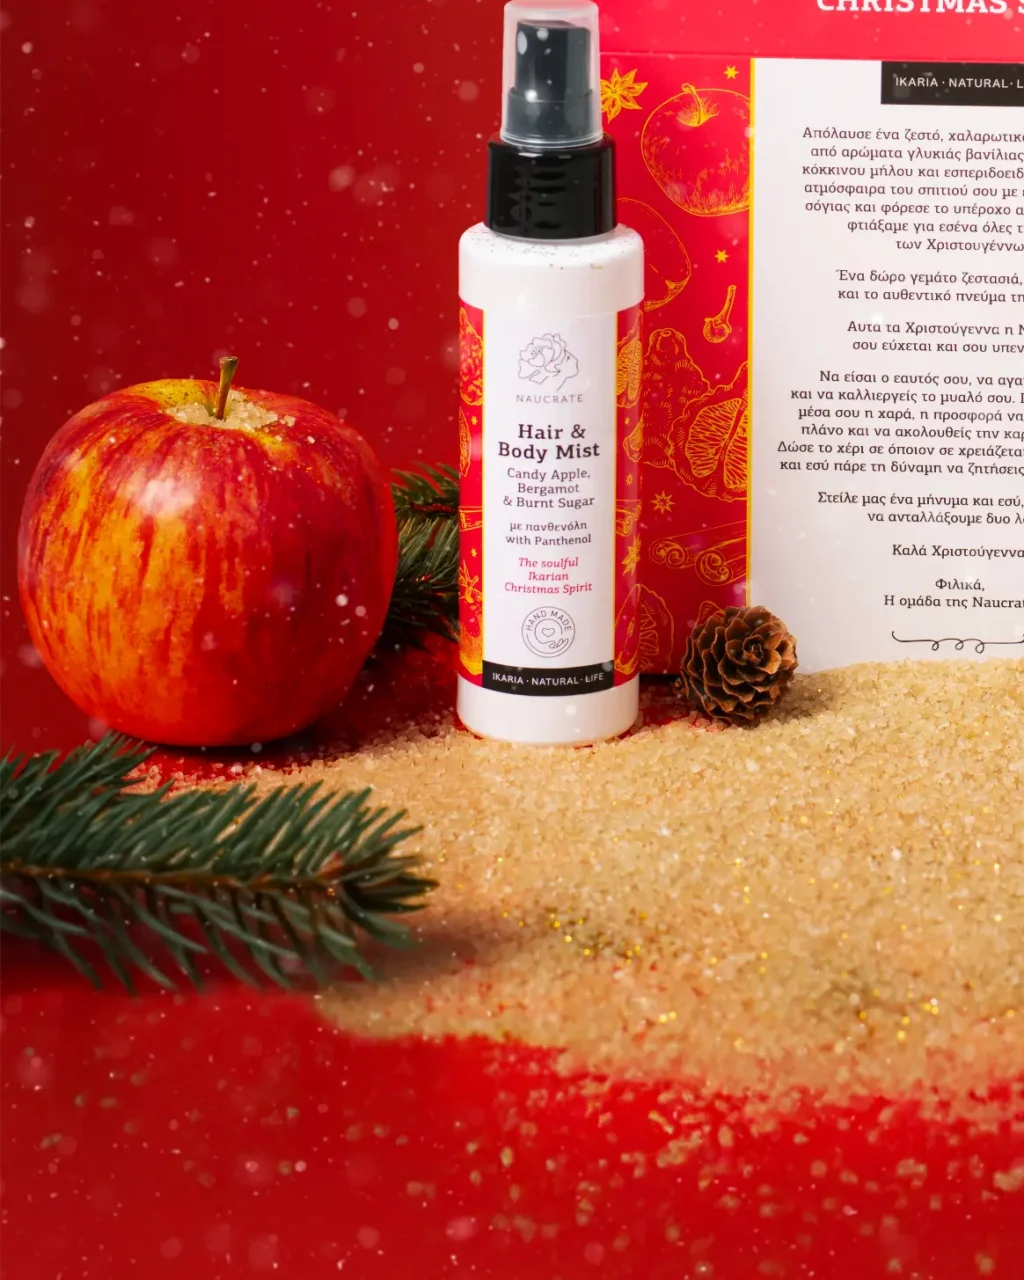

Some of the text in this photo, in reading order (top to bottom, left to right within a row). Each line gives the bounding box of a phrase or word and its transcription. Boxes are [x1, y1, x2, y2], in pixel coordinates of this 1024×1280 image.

[895, 76, 938, 88] IKARIA
[948, 77, 1009, 89] NATURAL
[802, 126, 872, 140] Απόλαυσε
[875, 127, 900, 140] ένα
[904, 128, 944, 143] ζεστό,
[810, 145, 837, 157] από
[841, 145, 903, 161] αρώματα
[906, 146, 962, 162] γλυκιάς
[802, 163, 866, 176] κόκκινου
[869, 164, 913, 180] μήλου
[917, 168, 940, 178] και
[847, 218, 909, 234] φτιάξαμε
[912, 222, 935, 235] για
[938, 220, 978, 233] εσένα
[982, 220, 1013, 236] όλες
[895, 240, 923, 250] των
[835, 269, 866, 282] Ένα
[869, 269, 906, 285] δώρο
[909, 271, 958, 286] γεμάτο
[837, 290, 860, 300] και
[863, 290, 879, 300] το
[882, 288, 952, 302] αυθεντικό
[955, 289, 1007, 306] πνεύμα
[846, 320, 882, 333] Αυτα
[885, 324, 901, 333] τα
[905, 321, 1000, 338] Χριστούγεννα
[852, 341, 878, 351] σου
[881, 338, 932, 352] εύχεται
[936, 343, 958, 352] και
[962, 343, 988, 353] σου
[819, 370, 840, 382] Να
[844, 370, 877, 383] είσαι
[893, 372, 940, 387] εαυτός
[943, 375, 972, 387] σου,
[976, 376, 994, 386] να
[516, 394, 583, 404] NAUCRATE
[790, 390, 813, 400] και
[816, 390, 834, 400] να
[838, 388, 918, 404] καλλιεργείς
[921, 393, 937, 402] το
[939, 390, 983, 406] μυαλό
[987, 394, 1016, 404] σου.
[518, 424, 586, 440] Hair &
[498, 441, 600, 463] Body Mist
[777, 440, 814, 453] Δώσε
[817, 444, 833, 454] το
[836, 441, 865, 457] χέρι
[868, 445, 884, 455] σε
[887, 442, 935, 456] όποιον
[938, 447, 955, 456] σε
[507, 467, 591, 482] Candy Apple,
[517, 483, 580, 497] Bergamot
[503, 496, 595, 510] & Burnt Sugar
[817, 491, 859, 504] Στείλε
[861, 495, 887, 507] μας
[889, 492, 914, 505] ένα
[916, 493, 969, 509] μήνυμα
[972, 497, 994, 507] και
[997, 495, 1024, 509] εσύ,
[867, 513, 885, 522] να
[887, 510, 983, 527] ανταλλάξουμε
[986, 512, 1011, 525] δυο
[509, 521, 587, 532] με πανθενόλη
[506, 534, 592, 546] with Panthenol
[892, 544, 928, 556] Καλά
[518, 557, 579, 571] The soulful
[528, 571, 569, 581] Ikarian
[504, 582, 593, 595] Christmas Spirit
[899, 595, 942, 609] ομάδα
[945, 598, 968, 610] της
[525, 610, 572, 632] HAND MADE
[492, 672, 604, 686] IKARIA NATURAL LIFE
